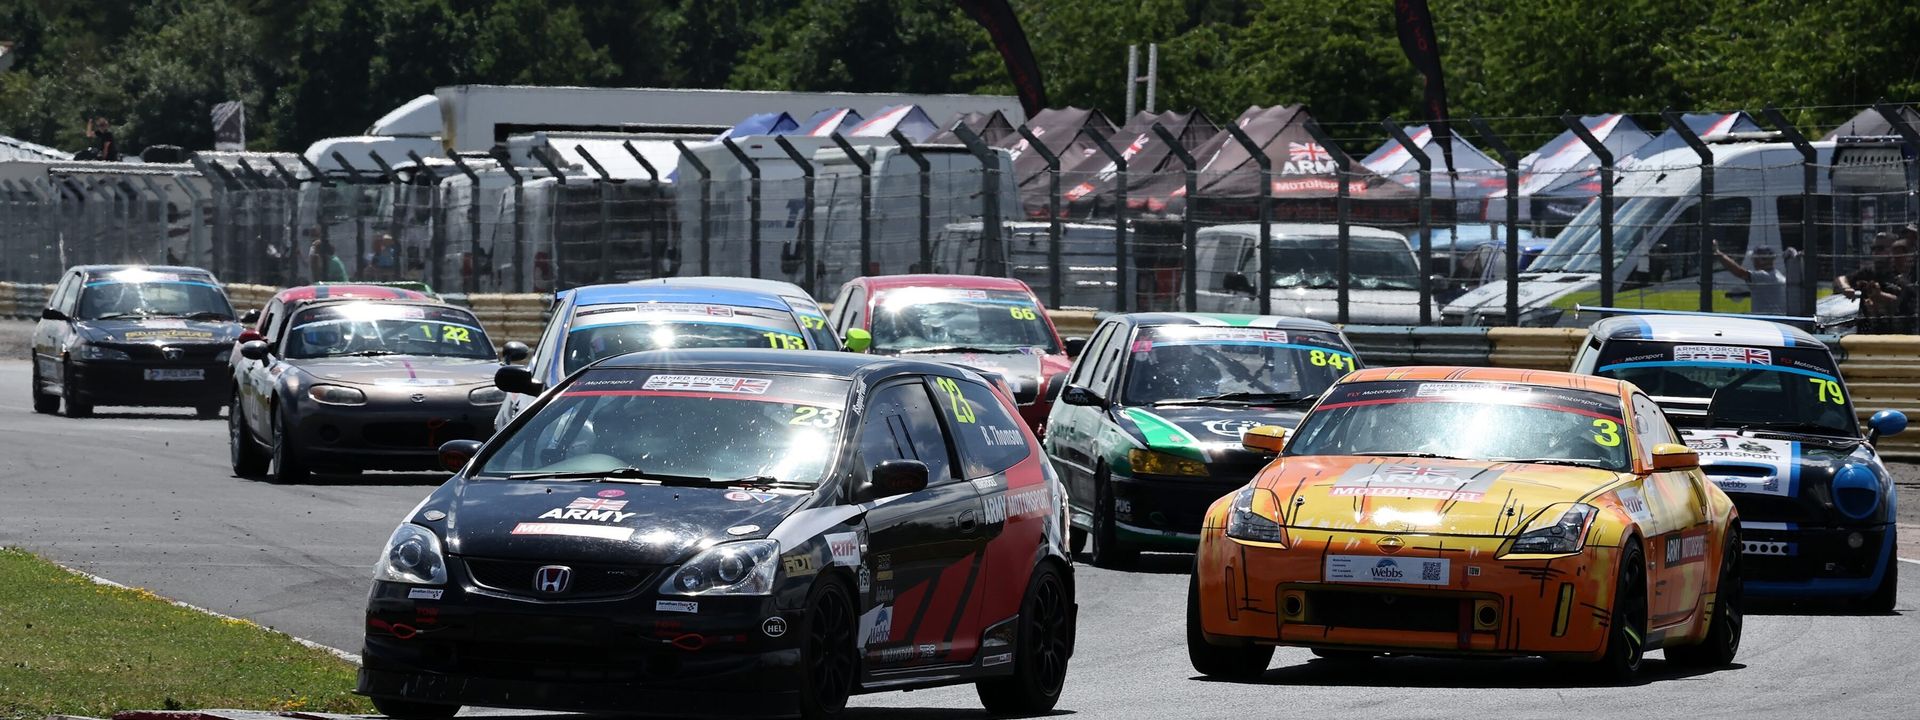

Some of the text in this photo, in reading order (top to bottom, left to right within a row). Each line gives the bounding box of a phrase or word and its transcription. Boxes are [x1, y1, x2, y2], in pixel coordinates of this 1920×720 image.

[1009, 306, 1037, 321] 66
[442, 324, 472, 343] 22
[763, 332, 806, 350] 113
[1624, 352, 1664, 362] Motorsport
[1709, 346, 1744, 354] FORCES
[1308, 349, 1357, 373] 841
[1794, 360, 1831, 375] Motorsport
[1361, 387, 1406, 396] Motorsport
[1809, 377, 1846, 405] 79
[936, 376, 976, 424] 23
[1557, 394, 1603, 407] Motorsport
[788, 405, 841, 429] 23
[989, 425, 1024, 446] Thomson
[1592, 418, 1621, 447] 3
[1355, 473, 1475, 486] ARMY
[1719, 480, 1747, 489] Webbs
[1333, 487, 1481, 500] MOTORSPORT
[983, 487, 1050, 525] ARMY MOTORSPORT
[538, 507, 636, 523] ARMY
[1666, 538, 1681, 563] ARMY
[1371, 567, 1404, 578] Webbs
[767, 625, 783, 633] HEL
